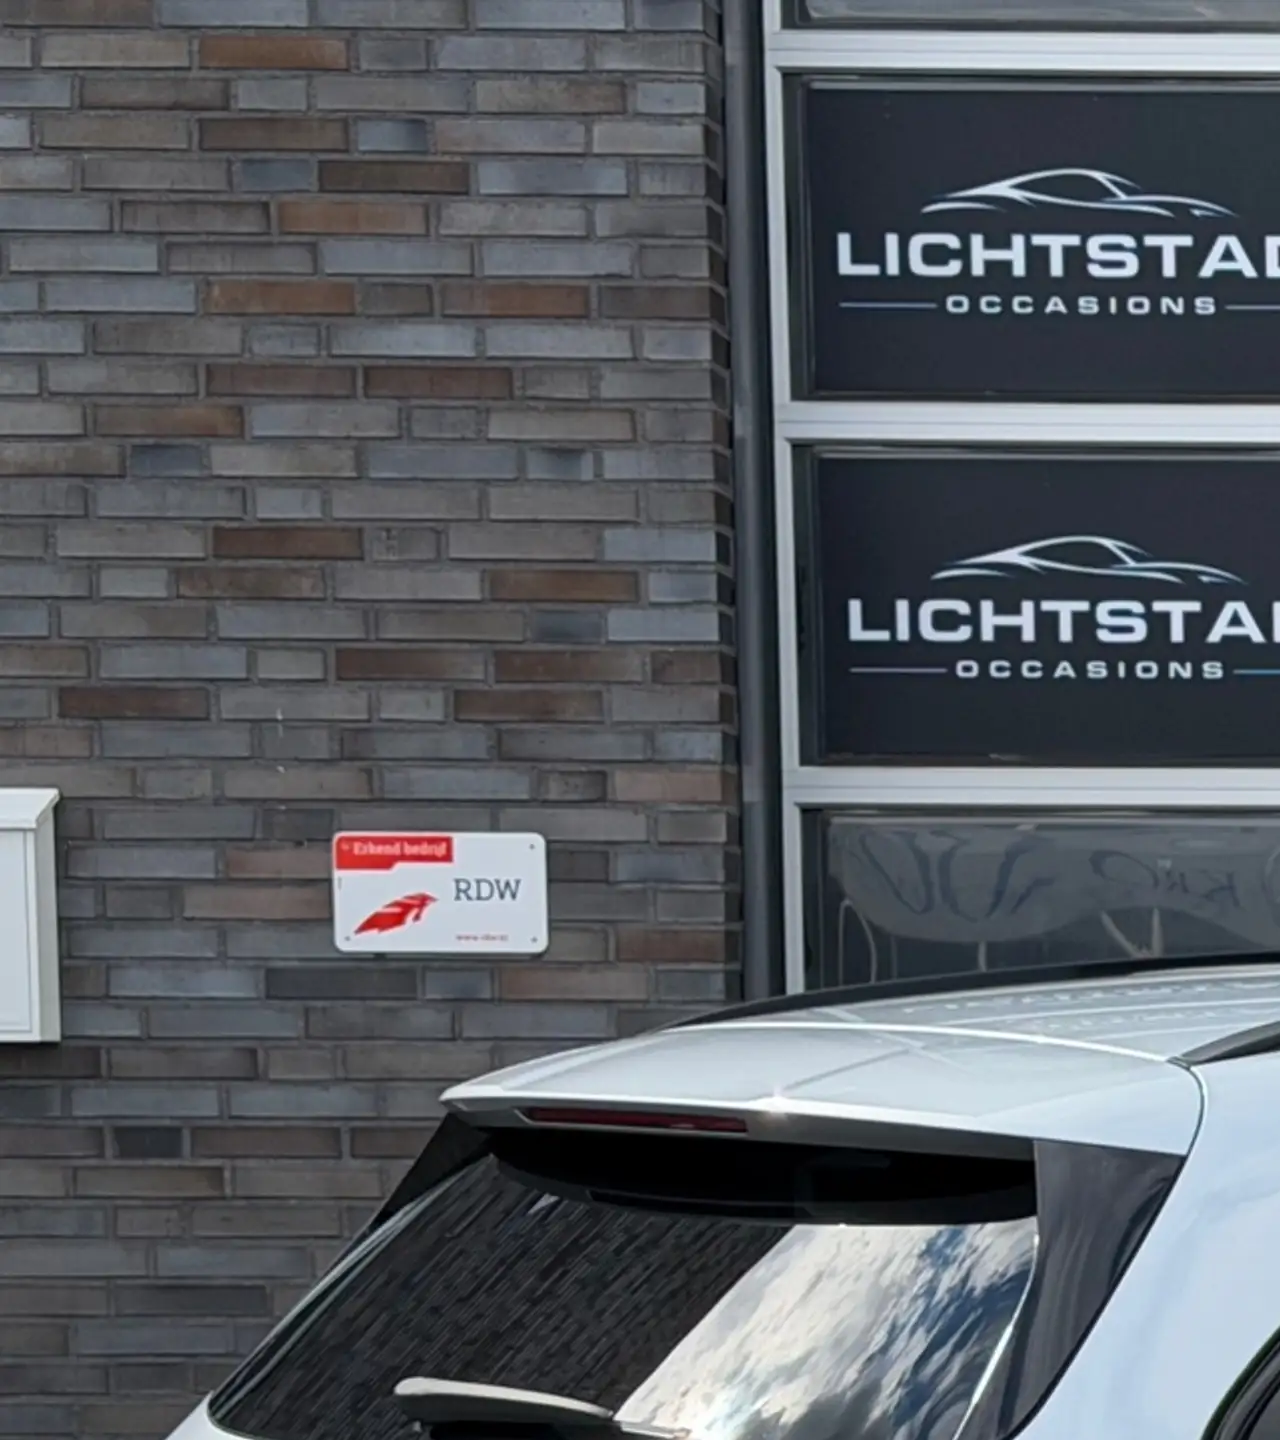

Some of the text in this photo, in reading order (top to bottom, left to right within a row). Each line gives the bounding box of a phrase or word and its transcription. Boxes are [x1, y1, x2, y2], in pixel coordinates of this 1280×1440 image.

[946, 295, 1216, 315] OCCASIONS
[956, 660, 1223, 679] OCCASIONS
[453, 877, 522, 902] RDW
